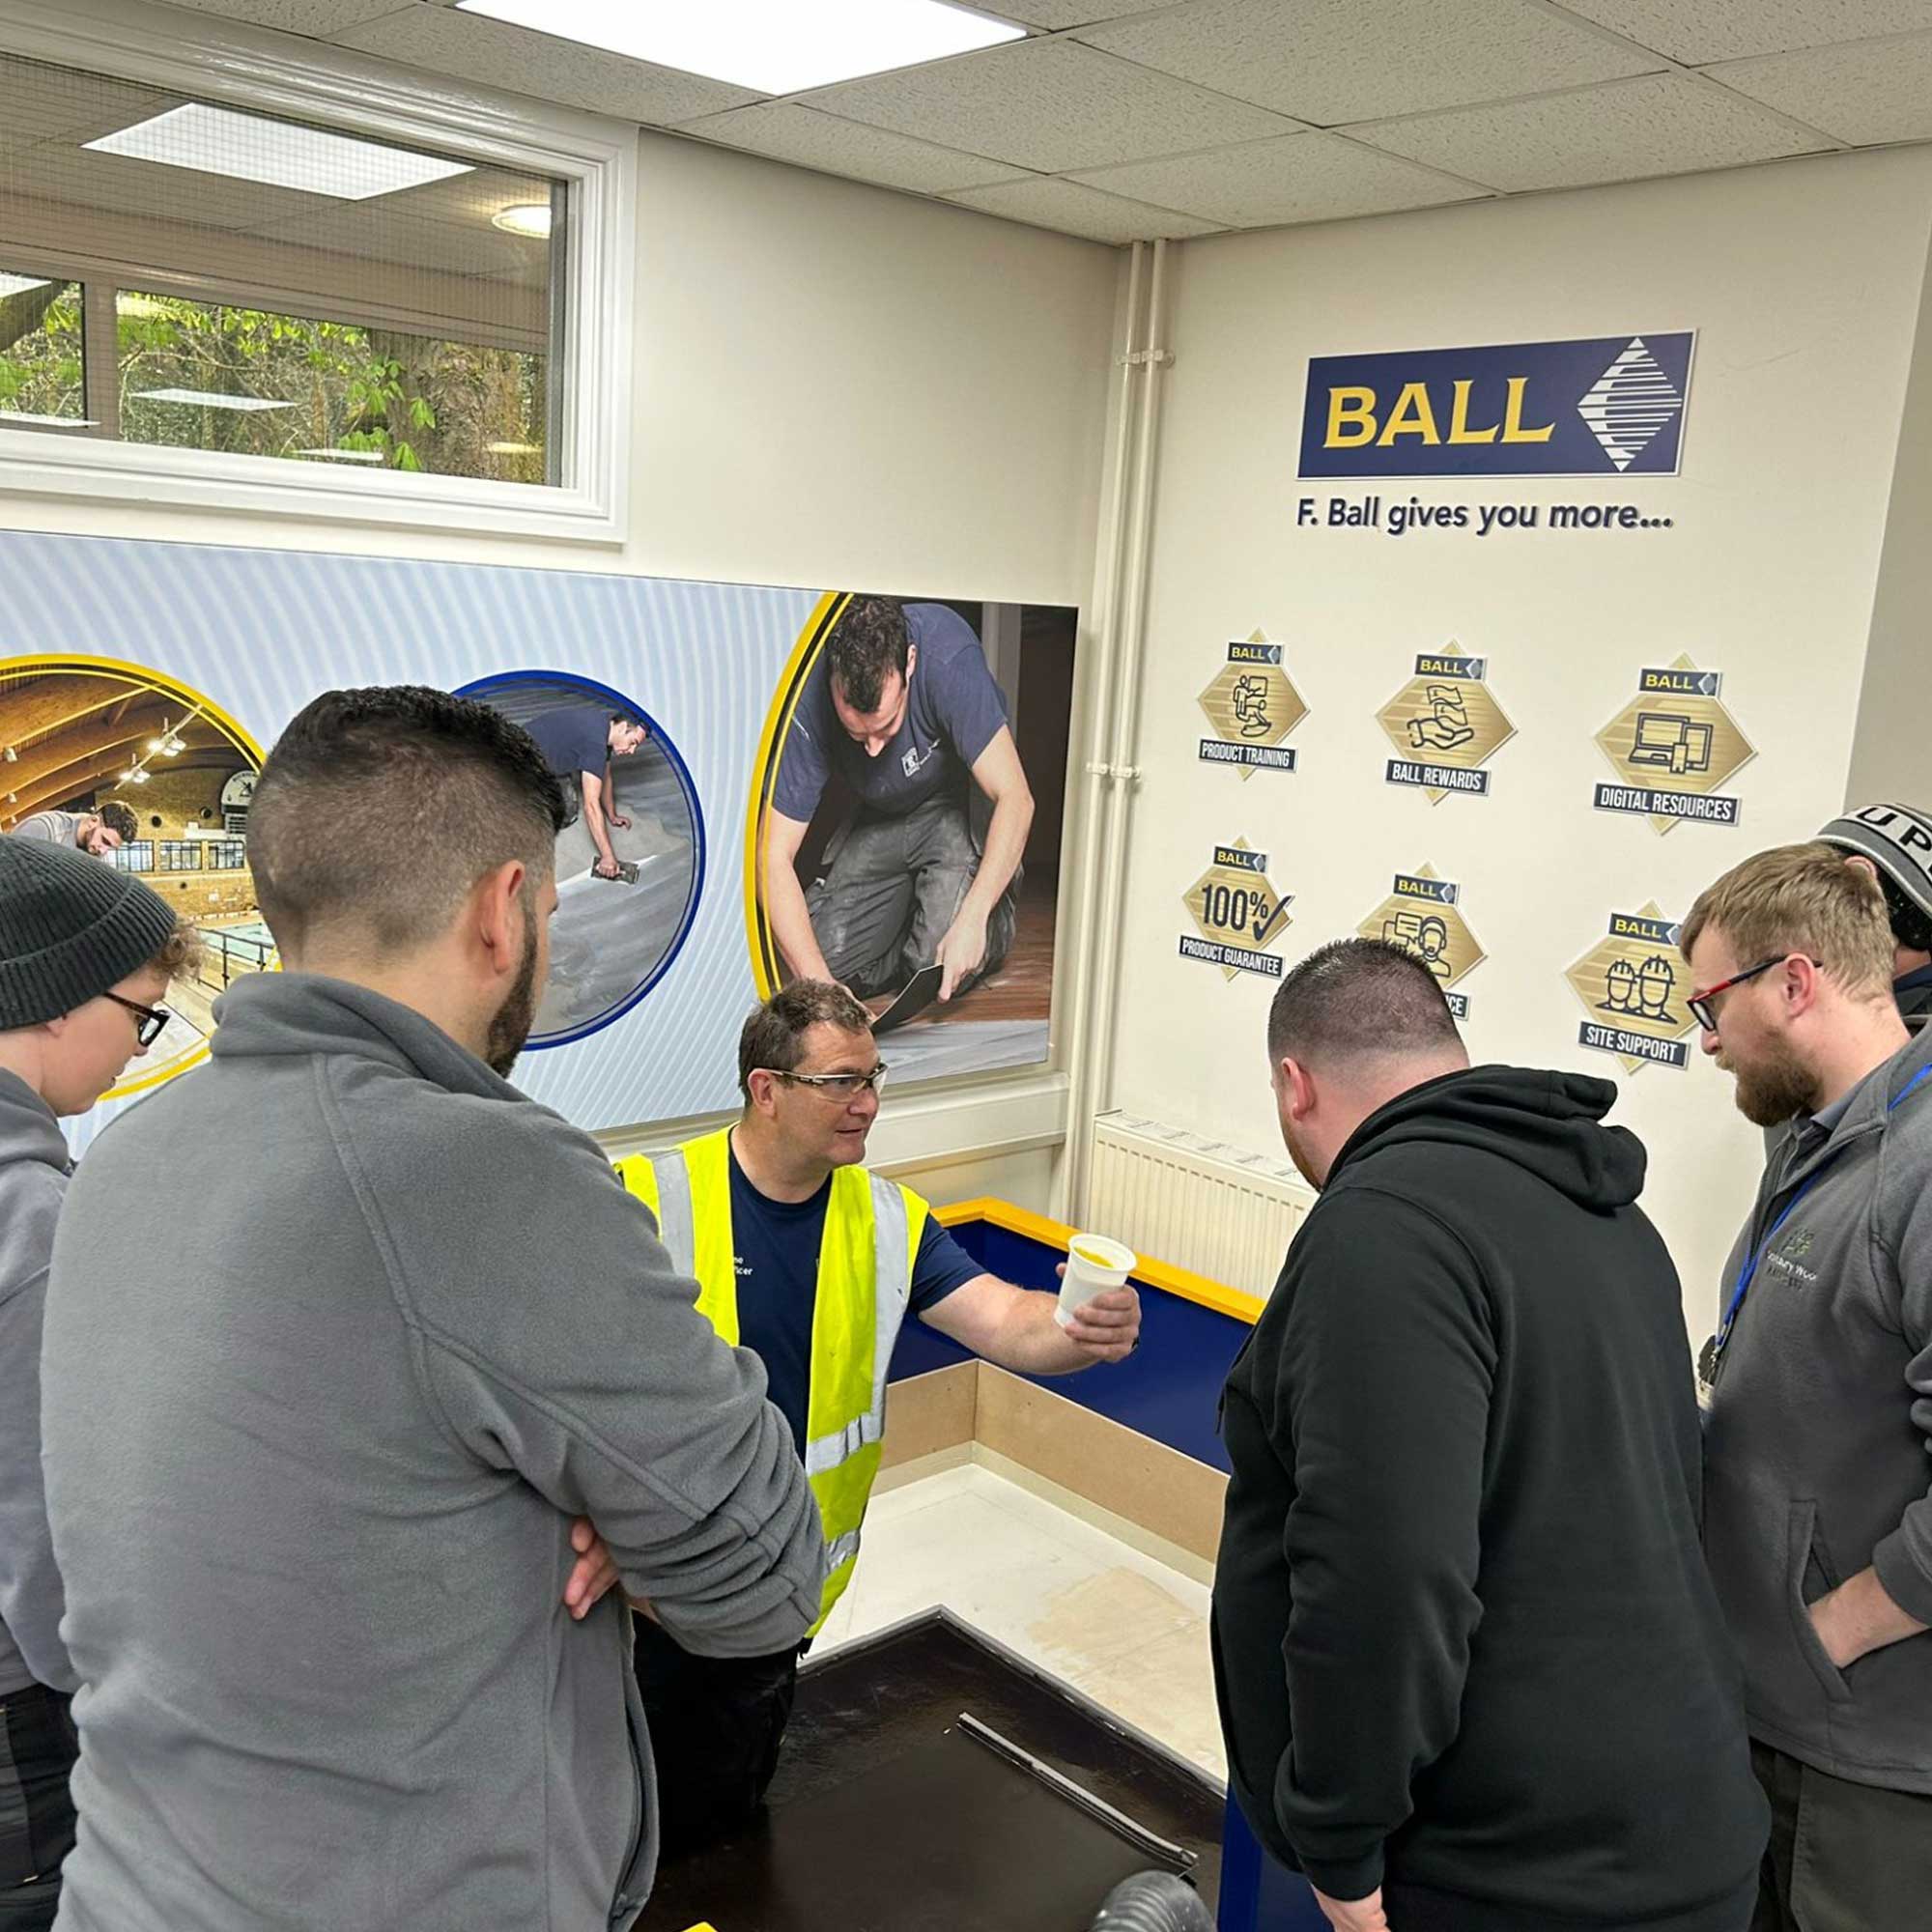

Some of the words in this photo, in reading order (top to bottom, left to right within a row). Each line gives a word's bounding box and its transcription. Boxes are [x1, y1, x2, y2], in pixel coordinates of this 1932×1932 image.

[1322, 377, 1555, 448] BALL
[1297, 497, 1318, 526] F.
[1327, 496, 1379, 527] Ball
[1387, 497, 1468, 535] gives
[1476, 502, 1538, 537] you
[1548, 502, 1673, 528] more...
[1231, 647, 1265, 660] BALL
[1420, 660, 1463, 673] BALL
[1645, 674, 1693, 690] BALL
[1201, 742, 1244, 762] PRODUCT
[1245, 748, 1290, 767] TRAINING
[1392, 763, 1421, 782] BALL
[1423, 767, 1482, 790] REWARDS
[1600, 787, 1649, 811] DIGITAL
[1652, 794, 1732, 820] RESOURCES
[1217, 851, 1250, 867] BALL
[1399, 880, 1437, 896] BALL
[1202, 883, 1269, 931] 100%
[1615, 919, 1662, 938] BALL
[1181, 939, 1223, 961] PRODUCT
[1224, 949, 1280, 975] GUARANTEE
[1586, 1026, 1615, 1048] SITE
[1617, 1032, 1678, 1063] SUPPORT
